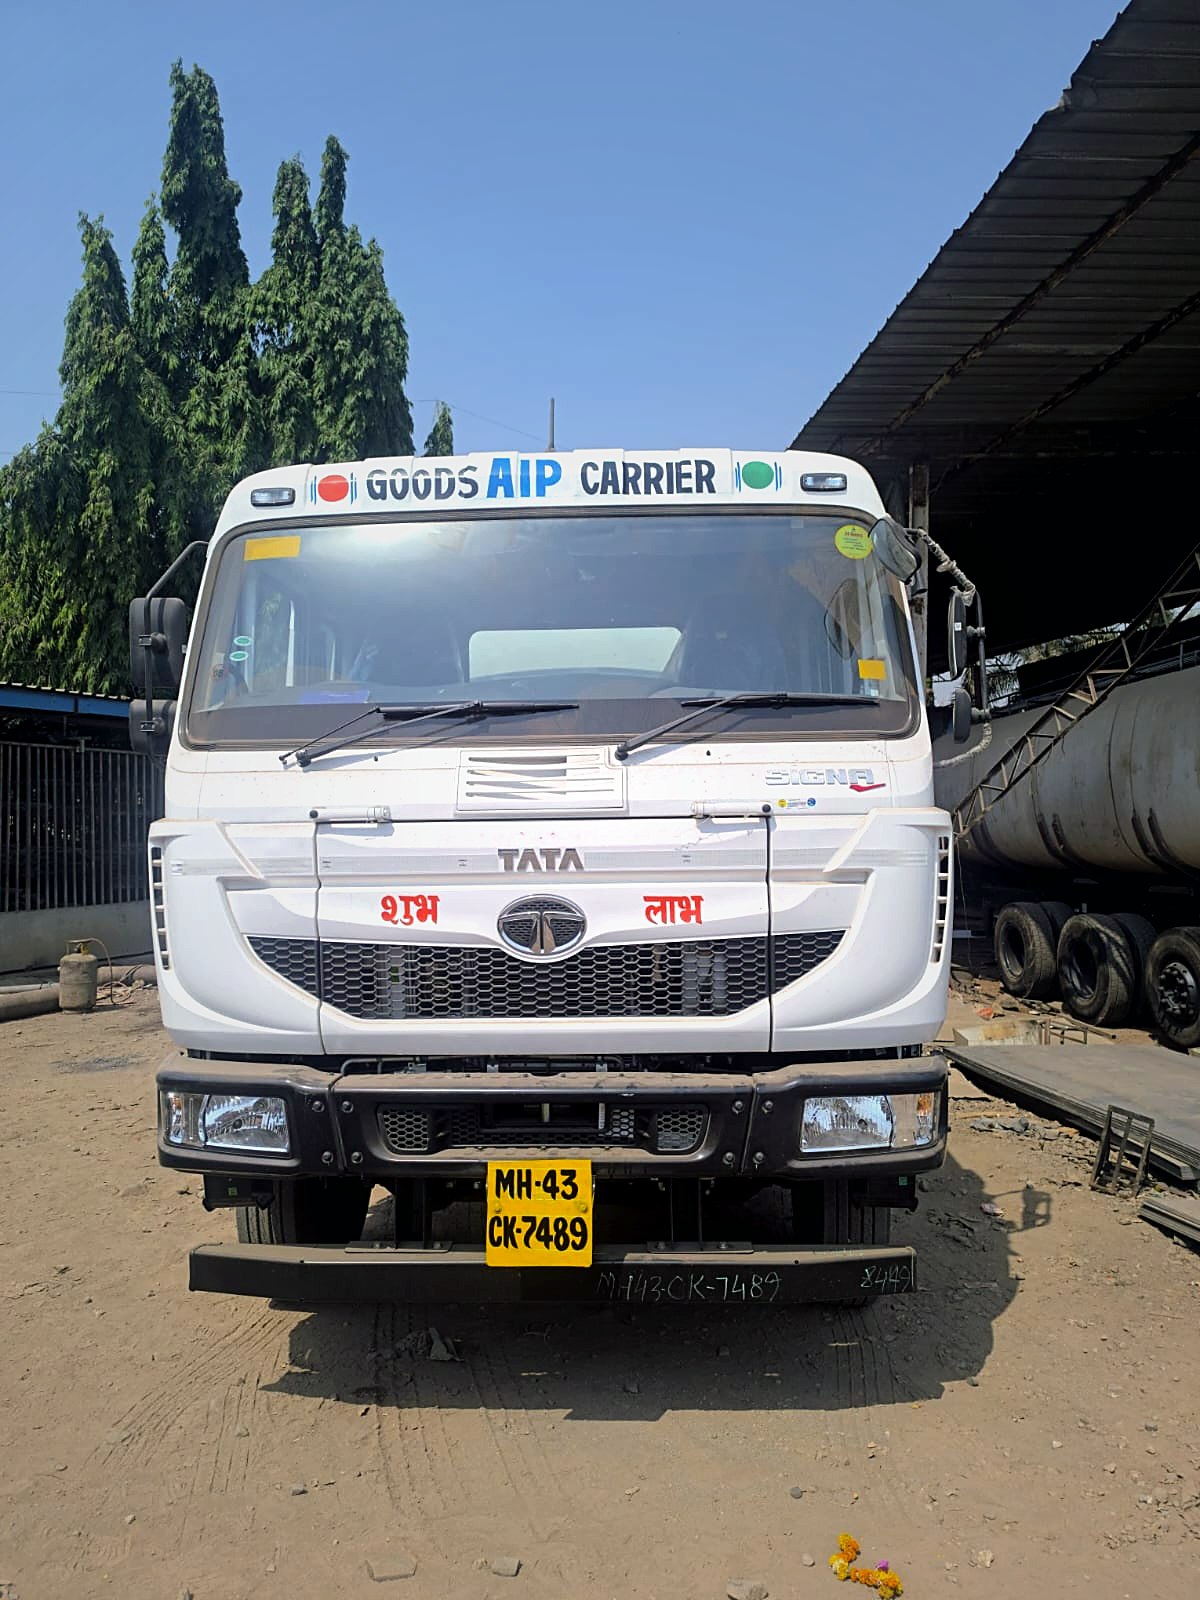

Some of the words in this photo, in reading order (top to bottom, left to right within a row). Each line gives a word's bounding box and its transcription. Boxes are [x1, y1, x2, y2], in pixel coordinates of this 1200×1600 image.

[366, 465, 479, 500] GOODS
[486, 457, 562, 498] AIP
[580, 459, 717, 495] CARRIER
[765, 768, 875, 786] SIGNA
[498, 848, 585, 872] TATA
[381, 894, 440, 926] शुभ
[643, 895, 705, 925] लाभ
[495, 1168, 579, 1200] MH-43
[488, 1215, 588, 1252] CK-7489
